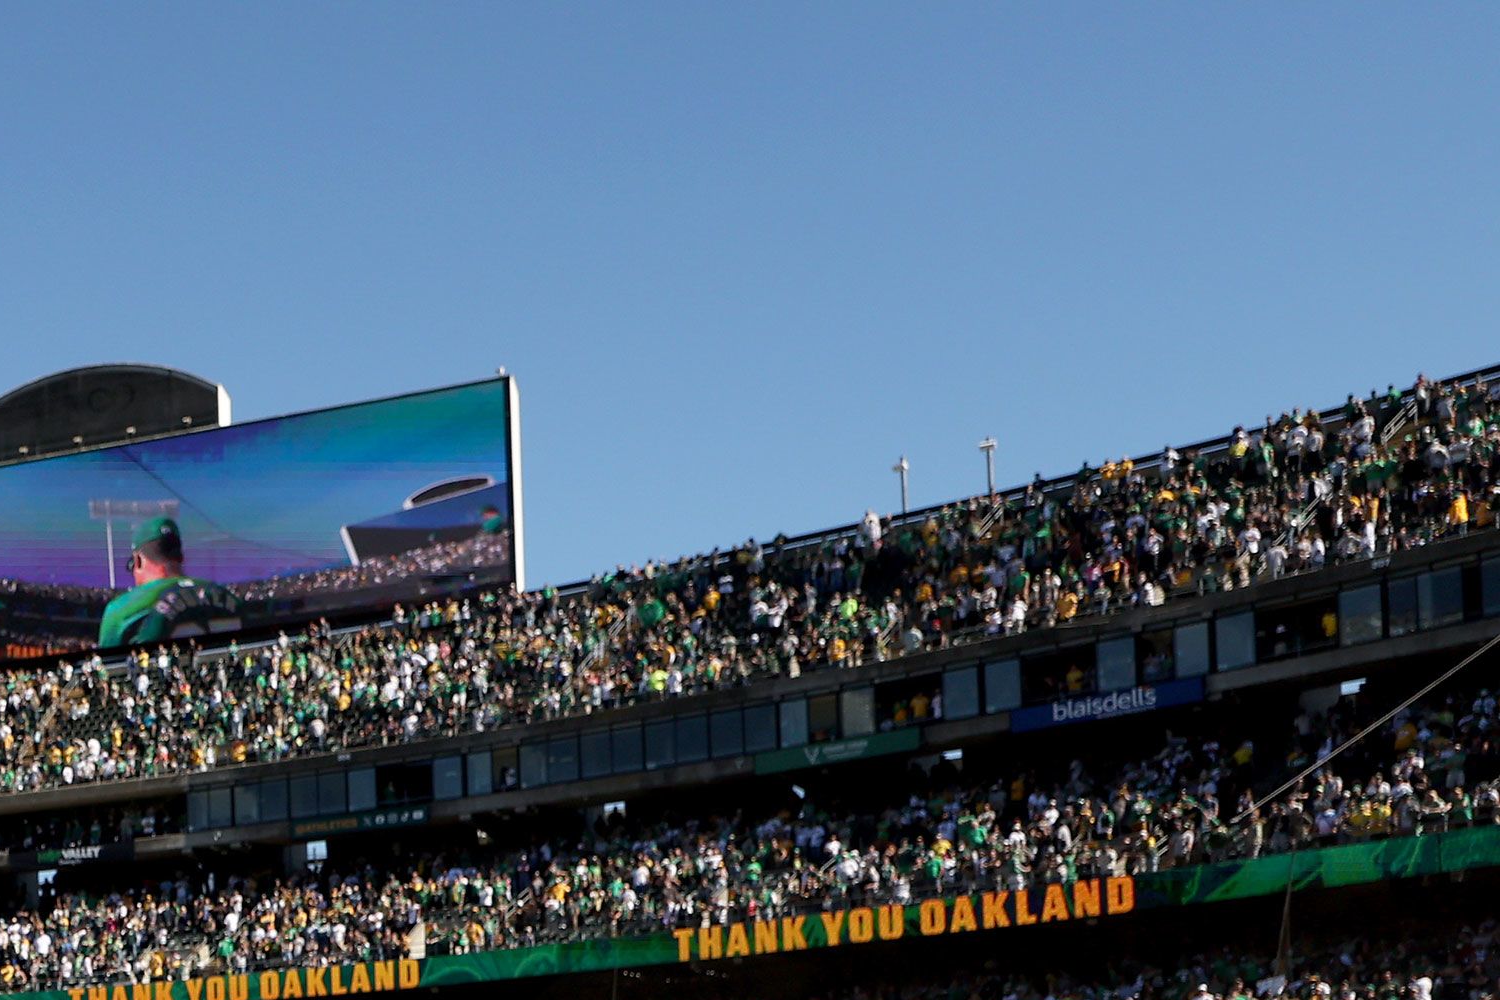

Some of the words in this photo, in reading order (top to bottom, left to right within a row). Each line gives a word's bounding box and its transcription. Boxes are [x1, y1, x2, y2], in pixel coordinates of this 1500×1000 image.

[1052, 686, 1157, 722] blaisdells
[61, 845, 101, 860] VALLEY
[672, 914, 810, 962] THANK
[820, 903, 904, 947] YOU
[919, 875, 1135, 937] OAKLAND
[259, 958, 421, 1000] OAKLAND
